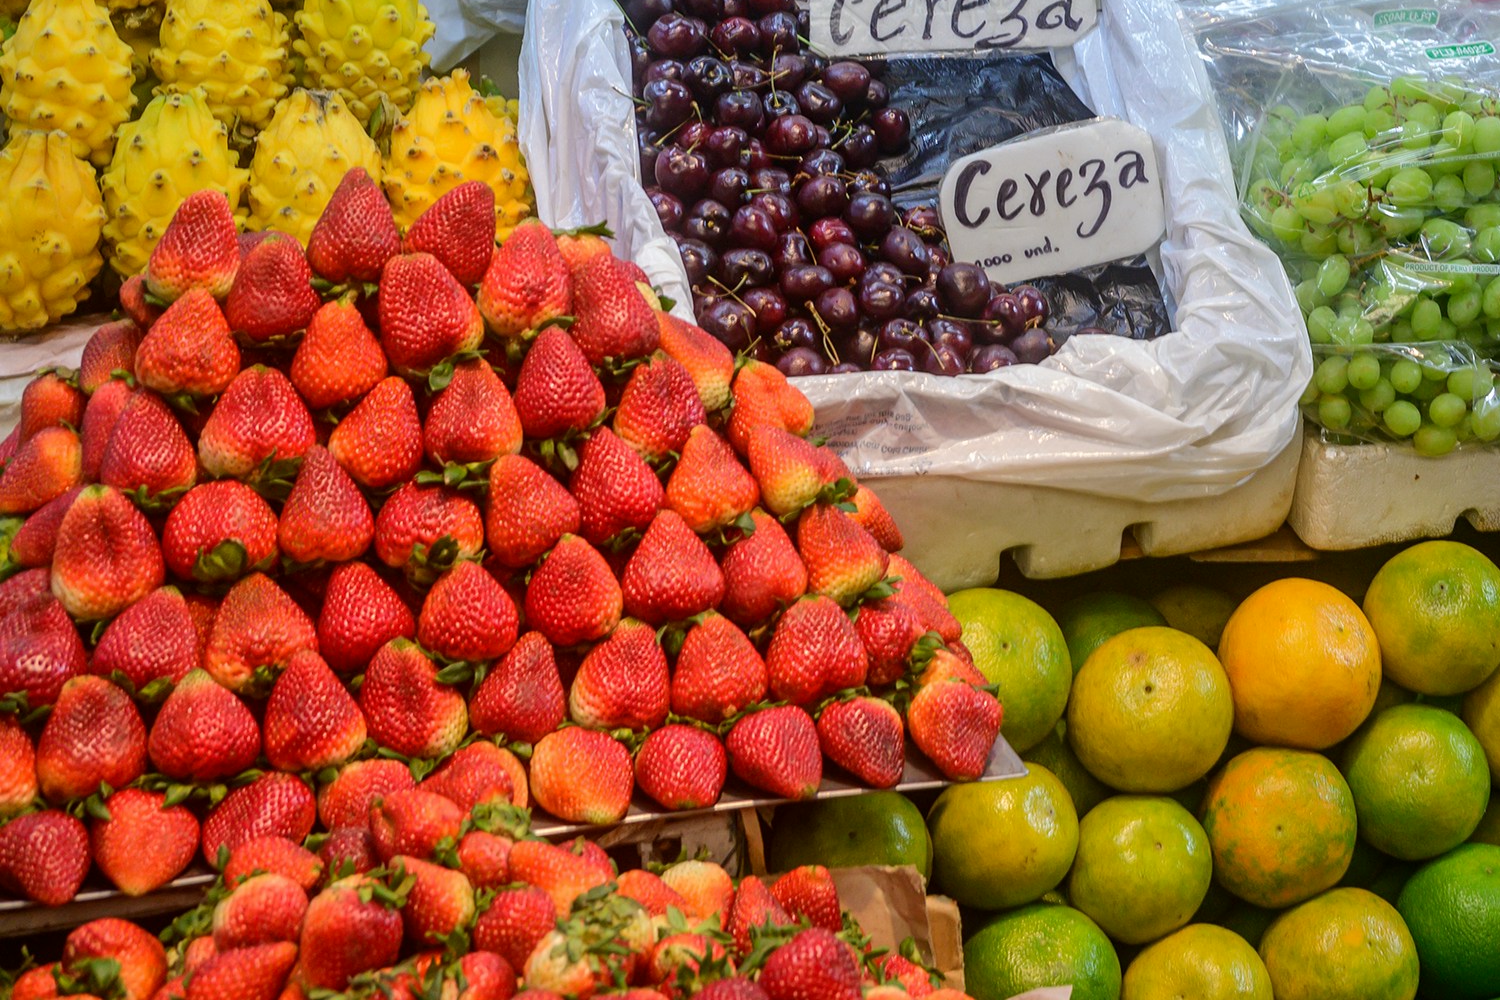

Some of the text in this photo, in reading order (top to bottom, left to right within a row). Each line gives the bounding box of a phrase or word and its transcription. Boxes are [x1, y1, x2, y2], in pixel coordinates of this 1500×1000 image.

[1431, 46, 1455, 58] PLU
[954, 150, 1149, 239] Cereza
[1024, 236, 1060, 259] und.
[1405, 263, 1439, 272] PRODUCT
[1440, 264, 1450, 272] OF
